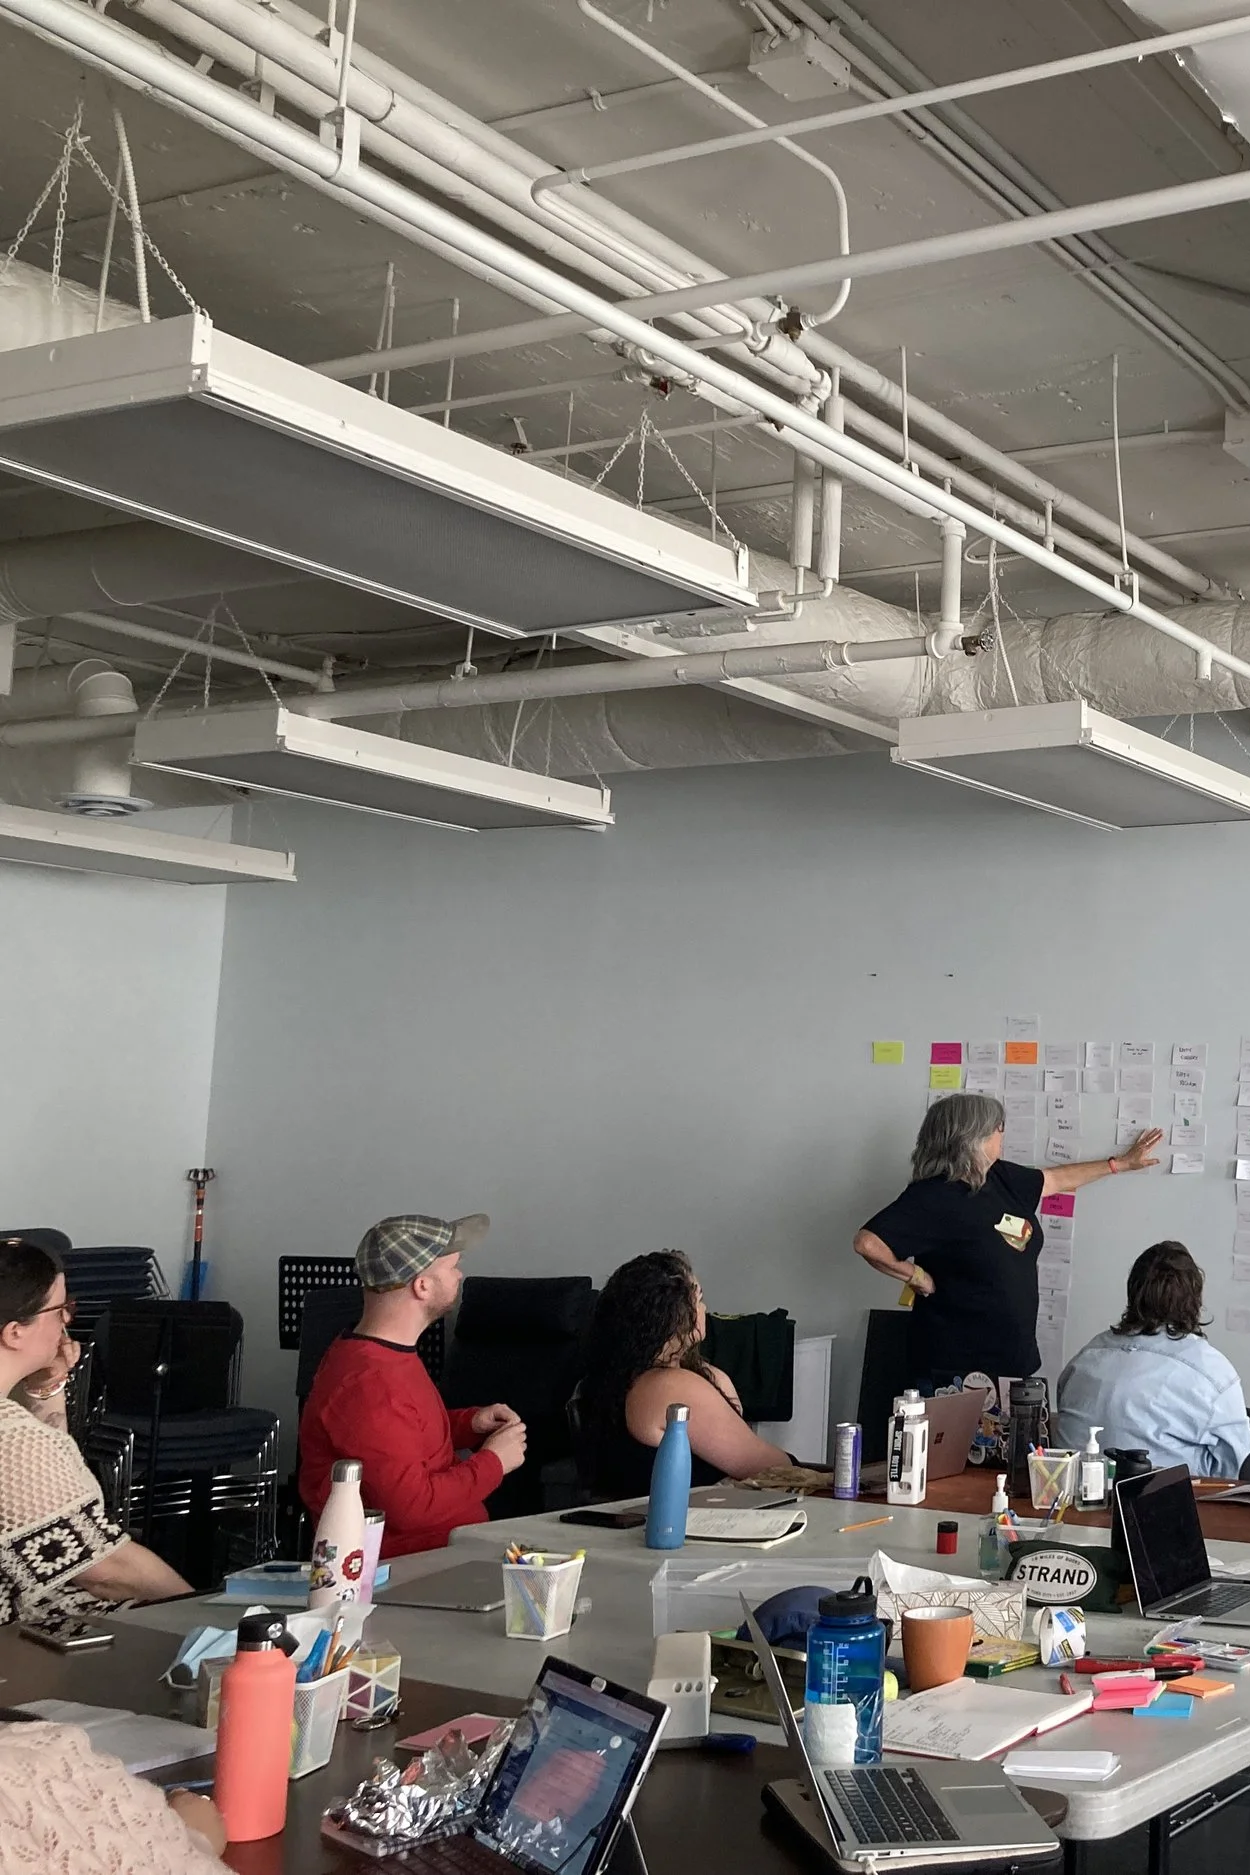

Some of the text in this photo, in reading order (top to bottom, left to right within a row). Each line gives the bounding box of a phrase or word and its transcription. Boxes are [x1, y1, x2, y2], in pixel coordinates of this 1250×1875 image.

[890, 1431, 903, 1479] SPORT BOTTLE
[1017, 1565, 1089, 1585] STRAND
